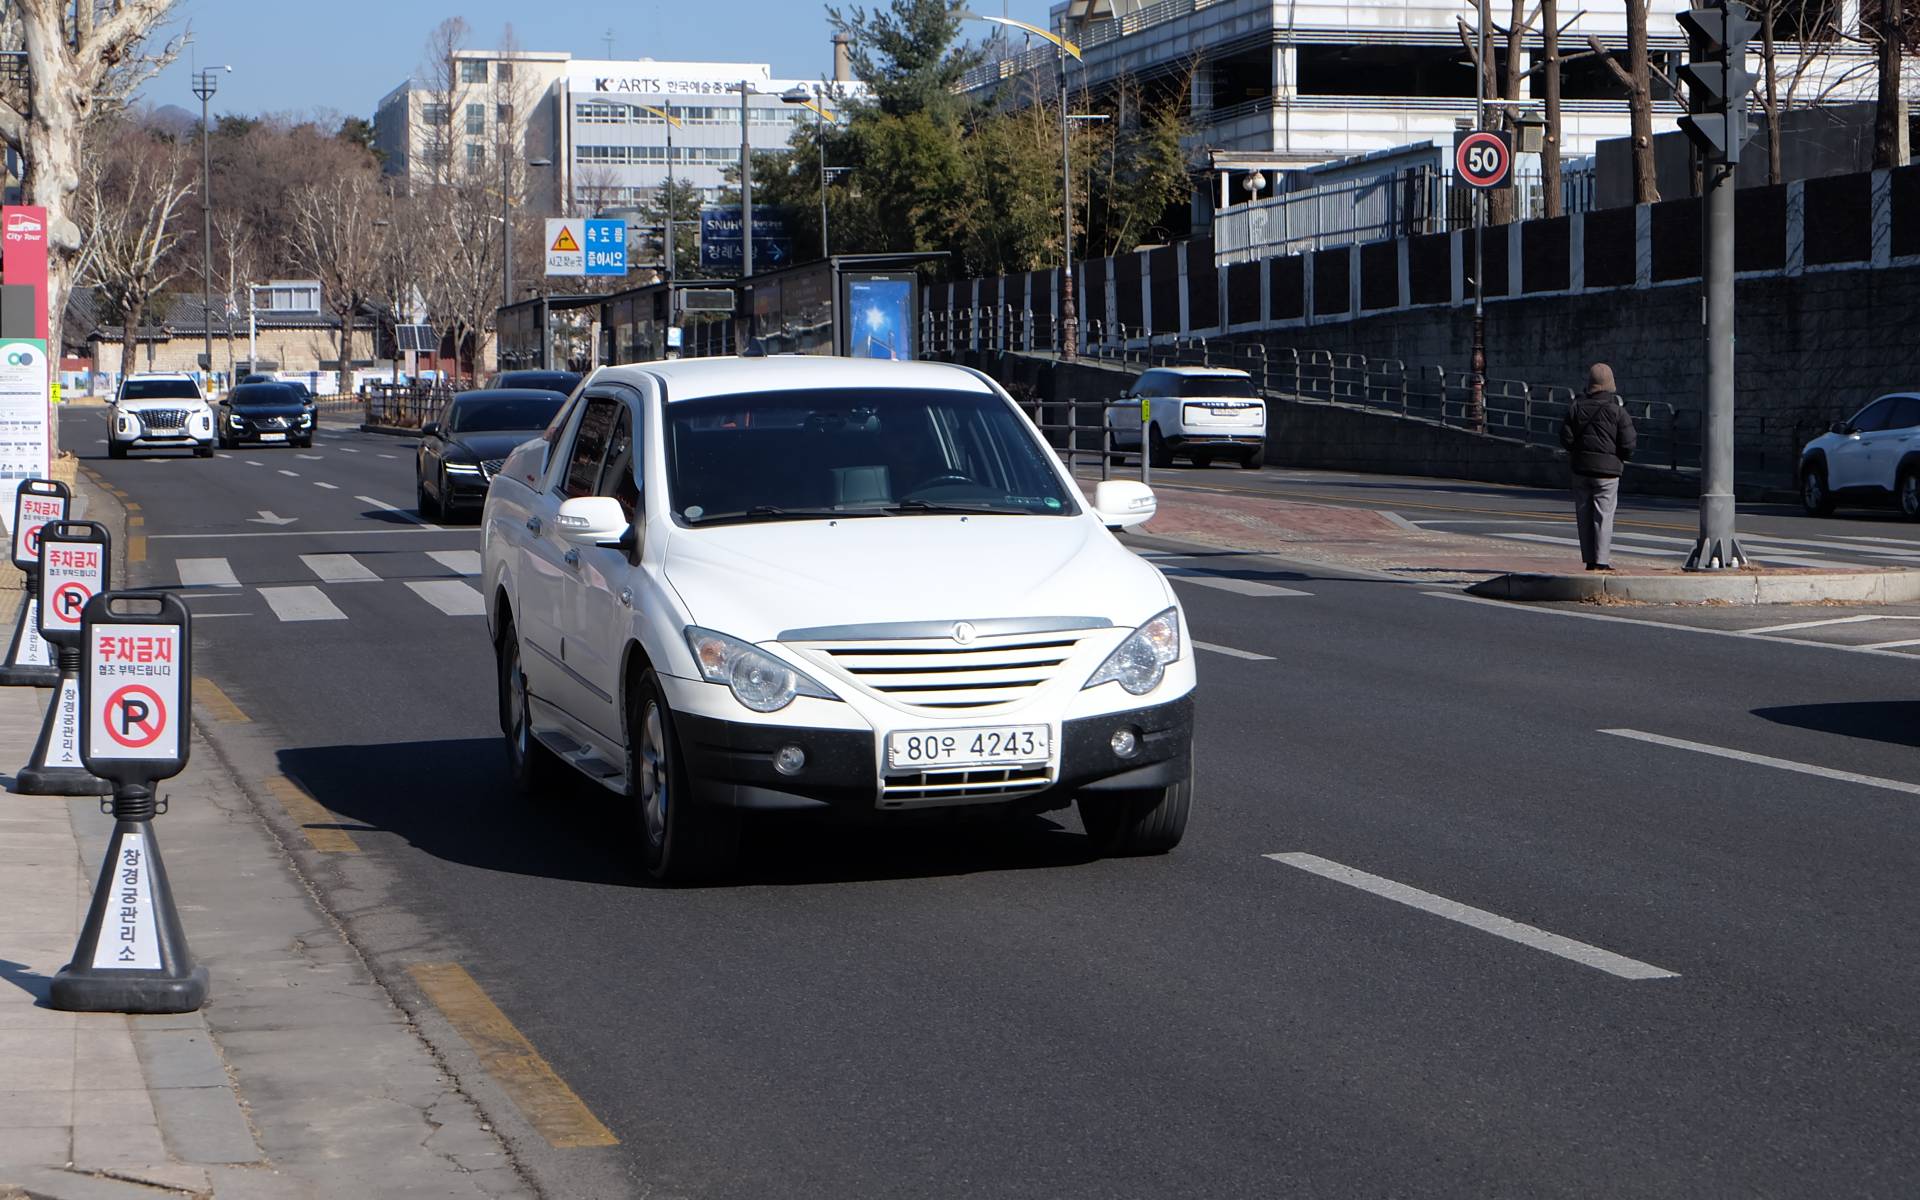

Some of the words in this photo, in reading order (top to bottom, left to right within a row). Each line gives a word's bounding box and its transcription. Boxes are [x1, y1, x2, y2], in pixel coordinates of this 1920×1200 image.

[617, 78, 661, 93] ARTS
[667, 81, 756, 94] 한국예술종합
[1469, 147, 1499, 172] 50
[587, 227, 623, 243] 속도를
[587, 251, 623, 267] 줄이시오
[24, 500, 60, 516] 주차금지
[50, 550, 97, 568] 주차금지
[98, 636, 172, 663] 주차금지
[98, 664, 116, 676] 협조
[118, 664, 172, 677] 부탁드립니다
[908, 735, 957, 761] 80우
[970, 730, 1035, 758] 4243
[118, 848, 141, 963] 창경궁관리소
